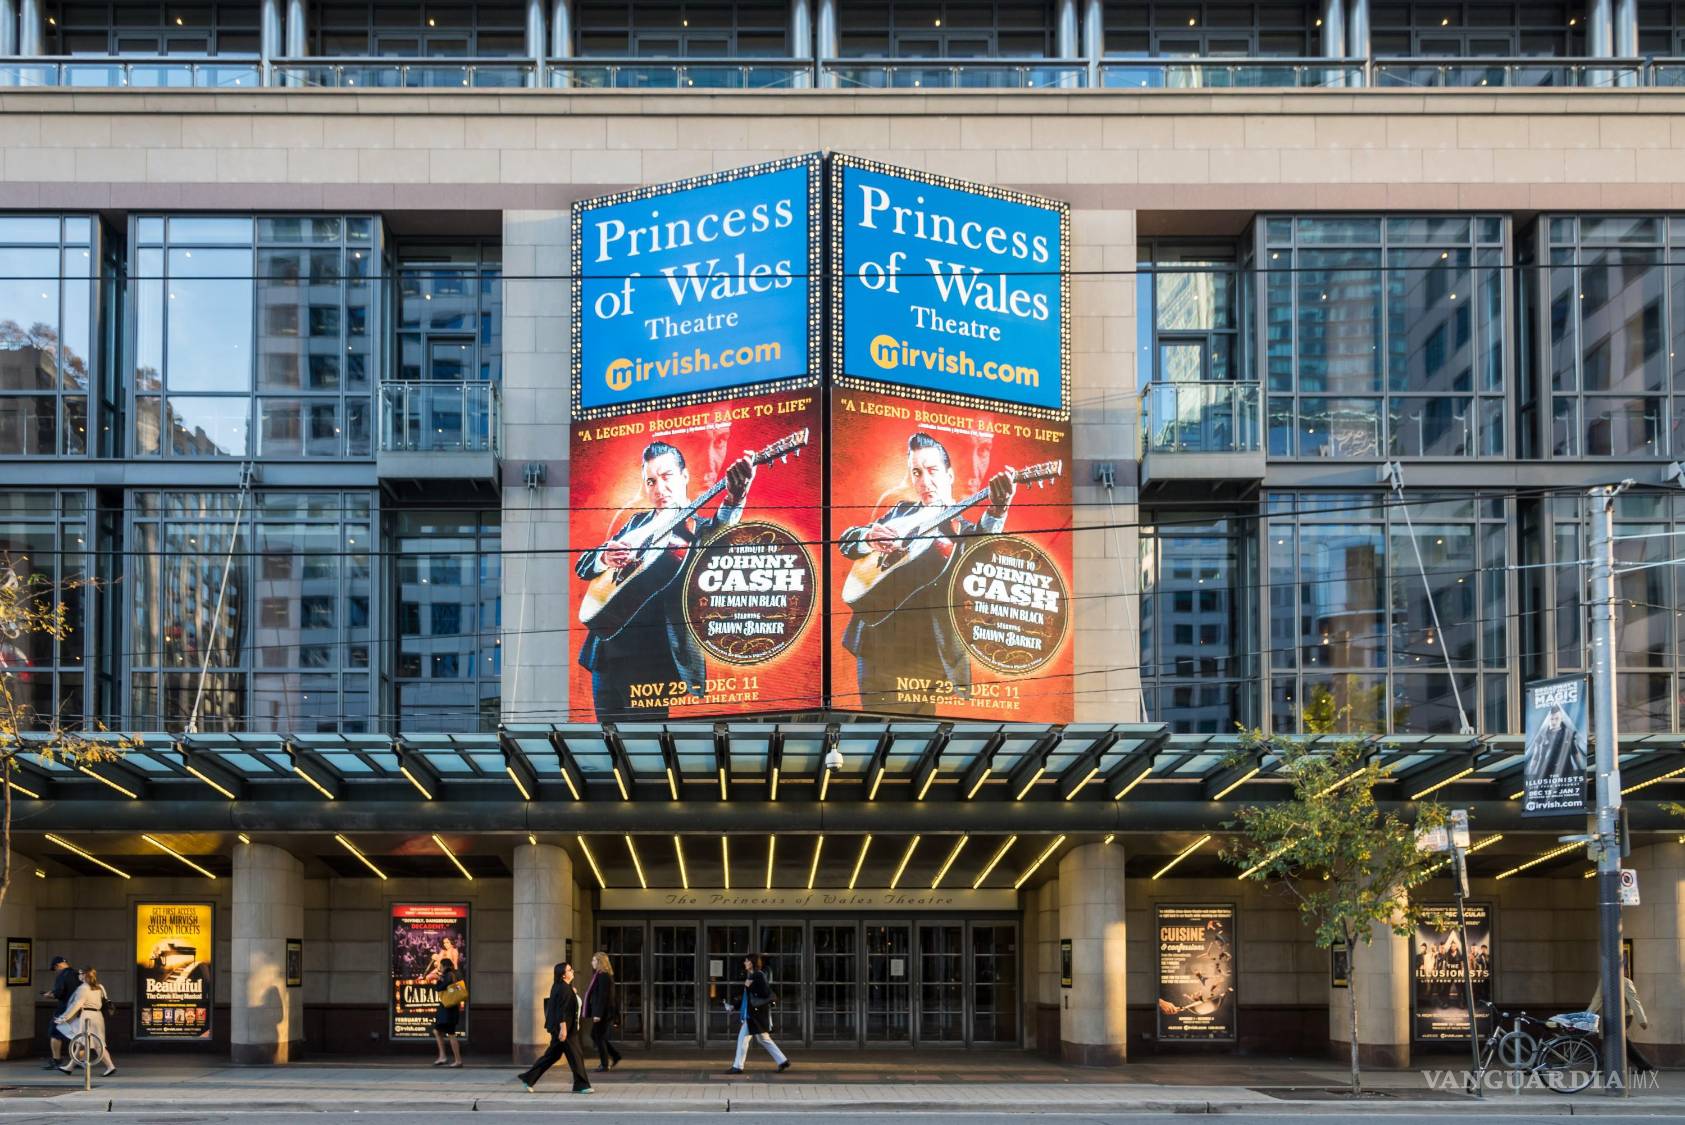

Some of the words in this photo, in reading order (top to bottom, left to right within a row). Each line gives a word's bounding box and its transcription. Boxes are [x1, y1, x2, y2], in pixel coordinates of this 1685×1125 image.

[595, 199, 793, 262] Princess
[858, 184, 1049, 263] Princess
[594, 272, 640, 319] of
[659, 253, 793, 306] Wales
[858, 252, 906, 293] of
[925, 258, 1049, 320] Wales
[644, 311, 739, 340] Theatre
[910, 305, 1001, 341] Theatre
[605, 341, 781, 391] mirvish.com
[870, 335, 1039, 387] mirvish.com
[596, 423, 644, 440] LEGEND
[649, 413, 710, 432] BROUGHT
[715, 407, 751, 422] BACK
[754, 404, 774, 417] TO
[778, 398, 812, 414] LIFE"
[860, 401, 911, 419] LEGEND
[914, 410, 974, 429] BROUGHT
[978, 419, 1010, 435] BACK
[1014, 425, 1031, 438] TO
[1035, 428, 1064, 443] LIFE"
[707, 555, 798, 570] JOHNNY
[698, 568, 805, 592] CASH
[971, 562, 1053, 589] JOHNNY
[710, 595, 727, 607] THE
[727, 595, 748, 607] MAN
[748, 595, 759, 607] IN
[759, 594, 787, 607] BLACK
[963, 574, 1060, 613] CASH
[974, 601, 989, 615] THE
[990, 603, 1009, 618] MAN
[1010, 606, 1019, 620] IN
[1020, 608, 1044, 625] BLACK
[630, 683, 665, 698] NOV
[668, 681, 687, 695] 29
[705, 678, 737, 692] DEC
[742, 676, 758, 690] 11
[896, 677, 931, 692] NOV
[935, 680, 954, 694] 29
[970, 683, 1000, 698] DEC
[1005, 686, 1020, 699] 11
[1535, 690, 1578, 704] MAGIC
[631, 696, 700, 708] PANASONIC
[703, 692, 759, 704] THEATRE
[897, 692, 966, 706] PANASONIC
[969, 698, 1020, 710] THEATRE
[1525, 776, 1584, 786] ILLUSIONISTS
[1525, 800, 1583, 811] mirvish.com
[163, 907, 176, 915] FIRST
[178, 907, 196, 915] ACCESS
[665, 895, 697, 904] The
[708, 894, 785, 904] Princess
[795, 895, 814, 906] of
[823, 895, 873, 904] Wales
[884, 895, 953, 904] Theatre
[147, 925, 173, 935] SEASON
[175, 925, 201, 935] TICKETS
[150, 915, 166, 925] WITH
[169, 915, 198, 925] MIRVISH
[1160, 927, 1205, 941] CUISINE
[1415, 969, 1490, 977] ILLUSIONSTS
[146, 978, 202, 993] Beautiful
[404, 985, 442, 1003] CABAR
